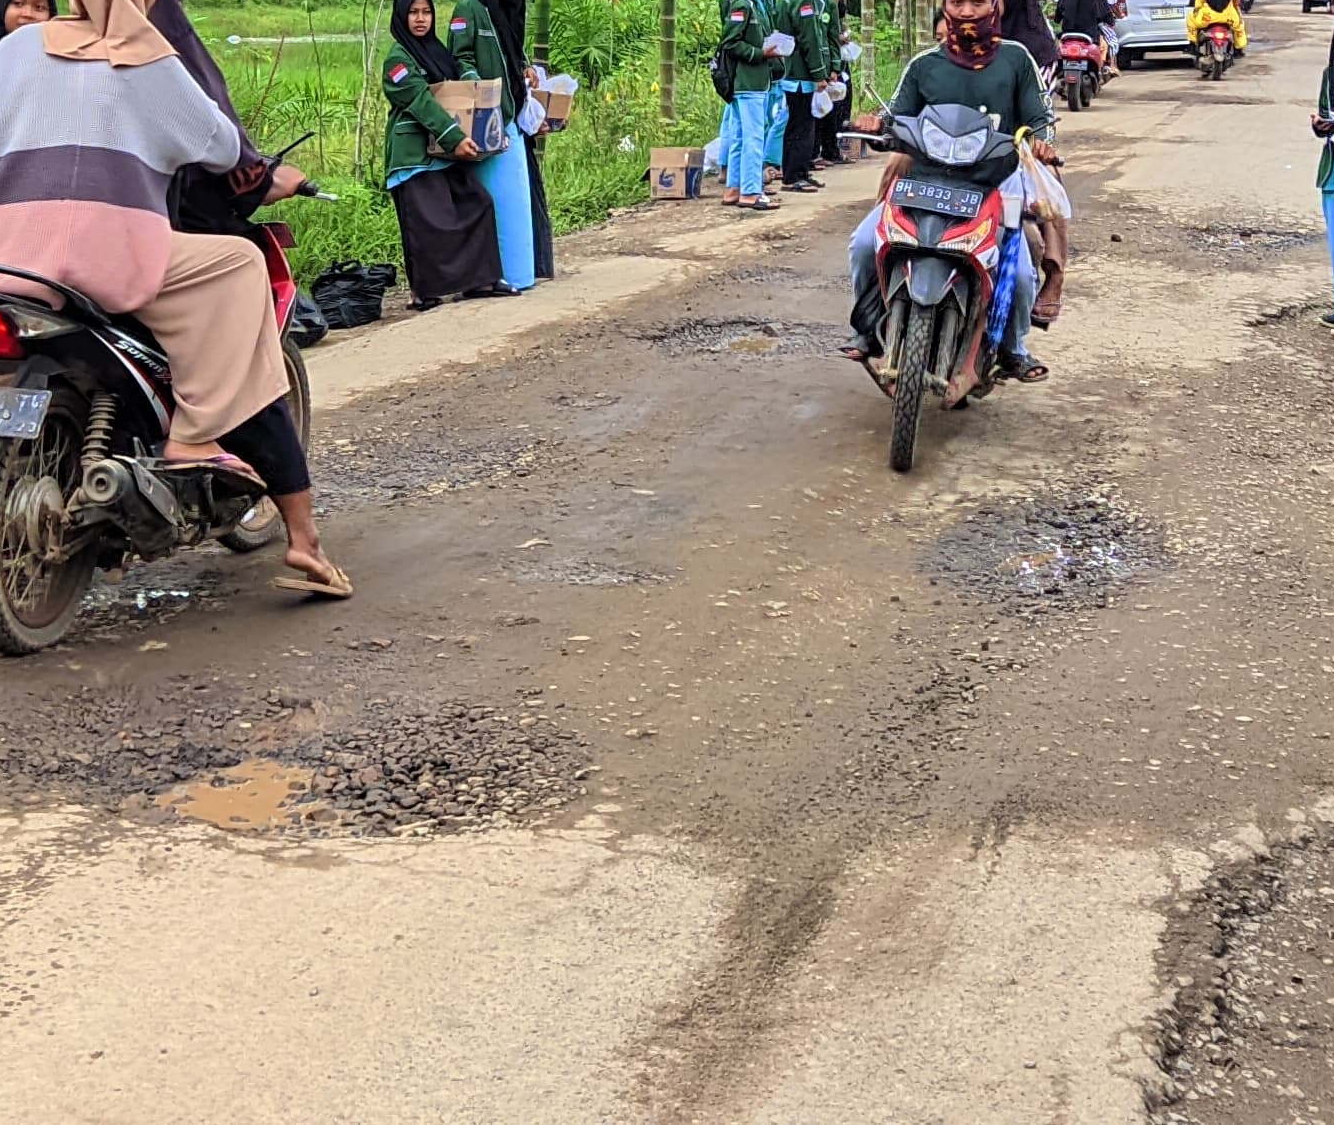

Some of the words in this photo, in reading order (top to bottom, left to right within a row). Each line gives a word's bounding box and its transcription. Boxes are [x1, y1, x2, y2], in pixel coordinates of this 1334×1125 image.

[895, 181, 913, 193] BH
[918, 185, 952, 200] 3833
[961, 193, 978, 205] JB
